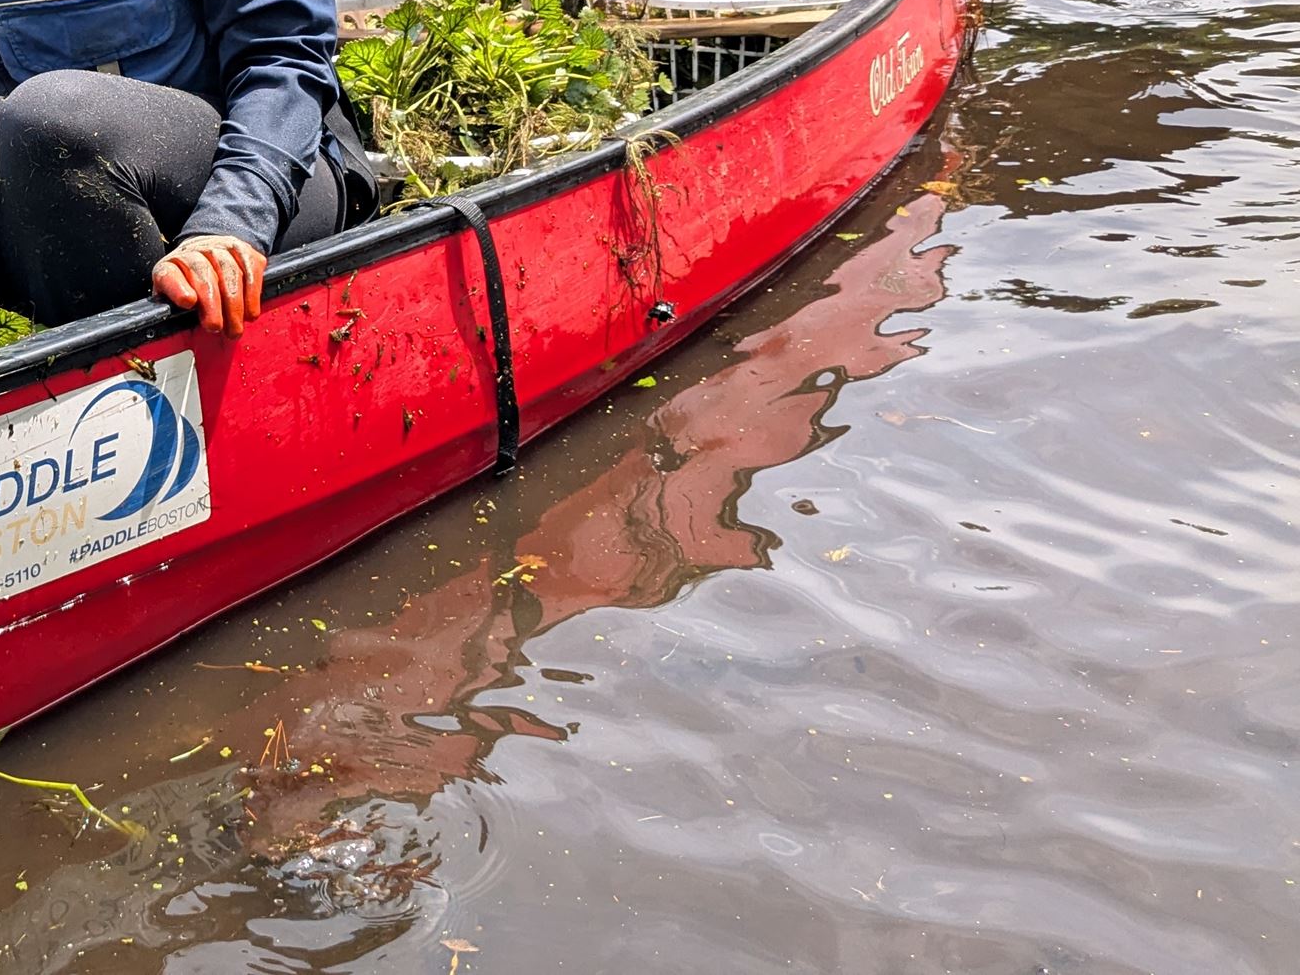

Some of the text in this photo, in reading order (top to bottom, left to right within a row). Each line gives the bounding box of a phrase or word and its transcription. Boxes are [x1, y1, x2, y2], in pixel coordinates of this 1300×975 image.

[869, 31, 924, 117] Old Town
[68, 493, 209, 564] #PADDLEBOSTON
